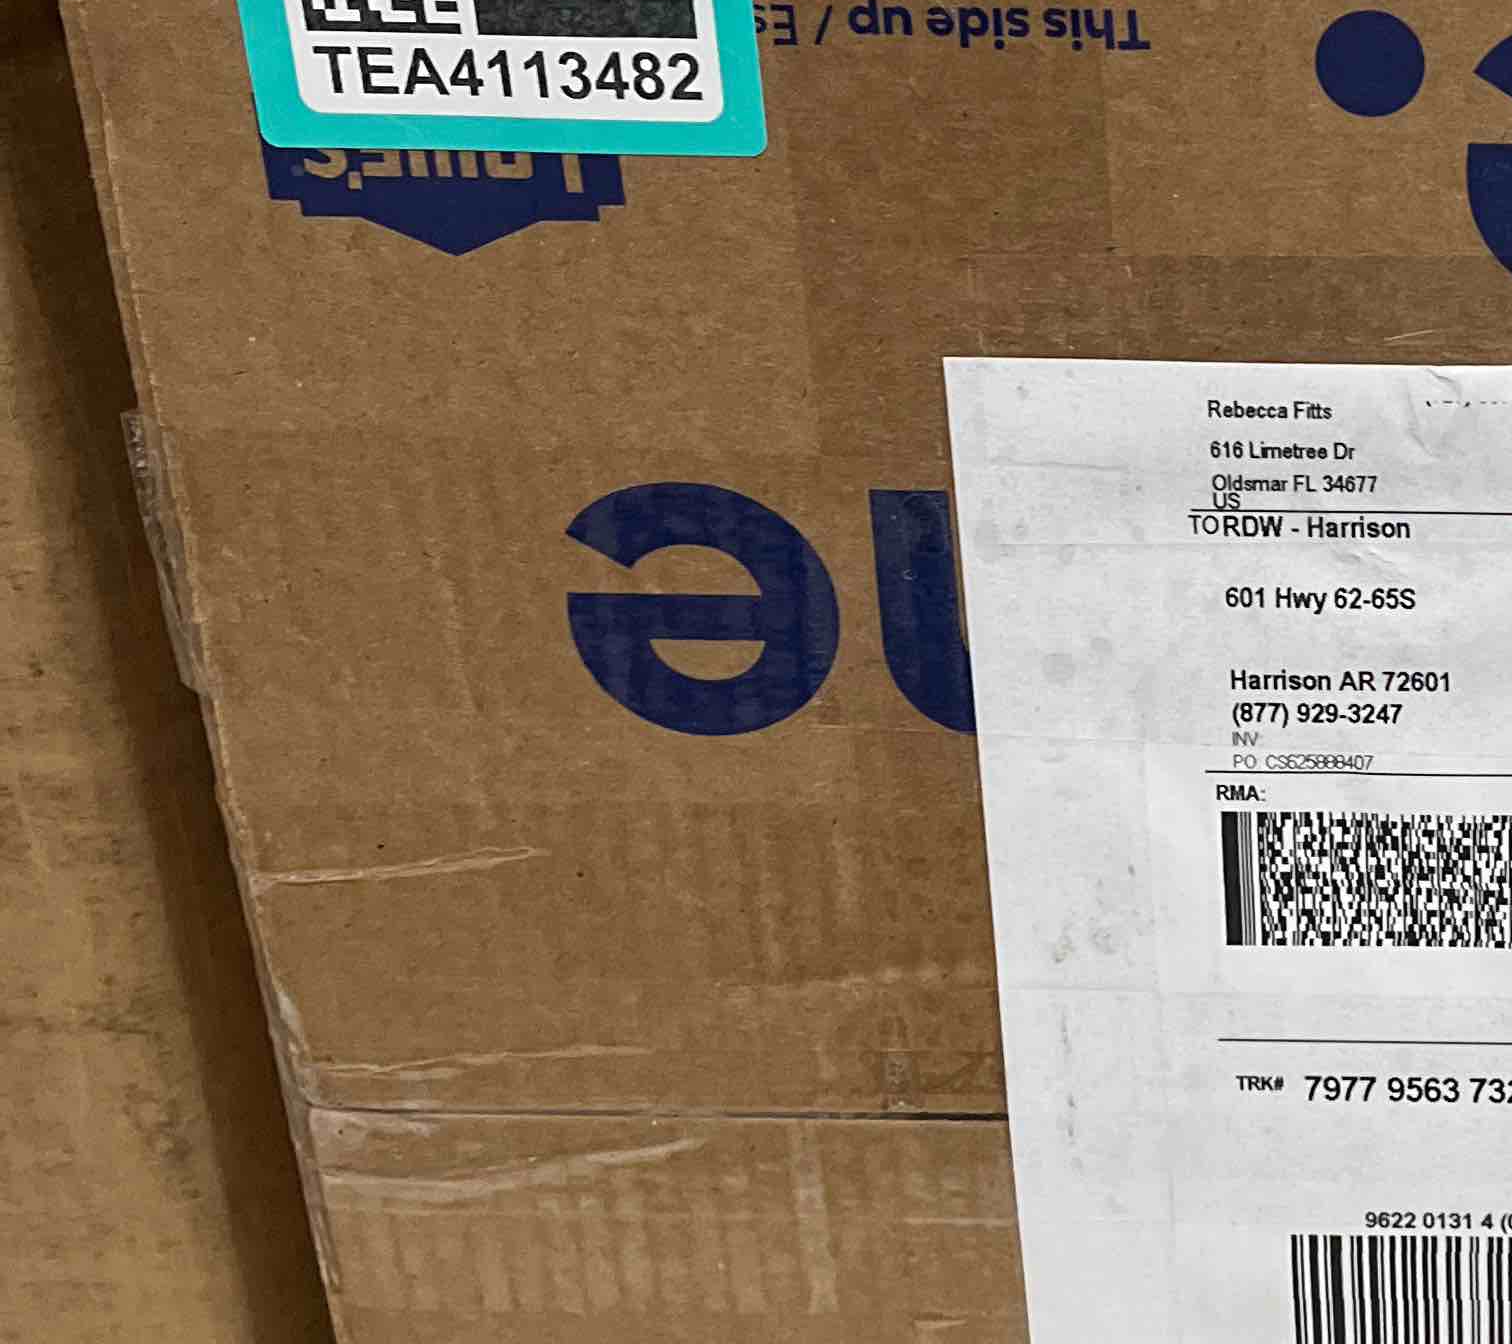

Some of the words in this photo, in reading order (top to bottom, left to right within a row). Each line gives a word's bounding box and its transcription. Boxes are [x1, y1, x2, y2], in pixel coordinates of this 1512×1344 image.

[926, 5, 1030, 51] side
[1043, 8, 1152, 51] This
[312, 45, 704, 102] TEA4113482
[1207, 400, 1288, 420] Rebecca
[1293, 401, 1333, 420] Fitts
[1210, 441, 1244, 459] 616
[1249, 441, 1328, 460] Limetree
[1333, 442, 1355, 461] Dr
[1212, 474, 1288, 493] Oldsmar
[1293, 475, 1317, 493] FL
[1323, 475, 1377, 494] 34677
[1212, 492, 1241, 510] US
[1306, 516, 1411, 539] Harrison
[1225, 587, 1265, 608] 601
[1275, 587, 1327, 614] Hwy
[1334, 587, 1416, 610] 62-65S
[1230, 669, 1332, 691] Harrison
[1339, 671, 1376, 692] AR
[1382, 671, 1451, 692] 72601
[1231, 702, 1289, 729] (877)
[1296, 703, 1402, 725] 929-3247
[1216, 784, 1267, 802] RMA:
[1236, 1076, 1284, 1091] TRK#
[1304, 1076, 1377, 1102] 7977
[1387, 1077, 1460, 1103] 9563
[1364, 1211, 1416, 1229] 9622
[1423, 1212, 1473, 1230] 0131
[1480, 1213, 1494, 1230] 4
